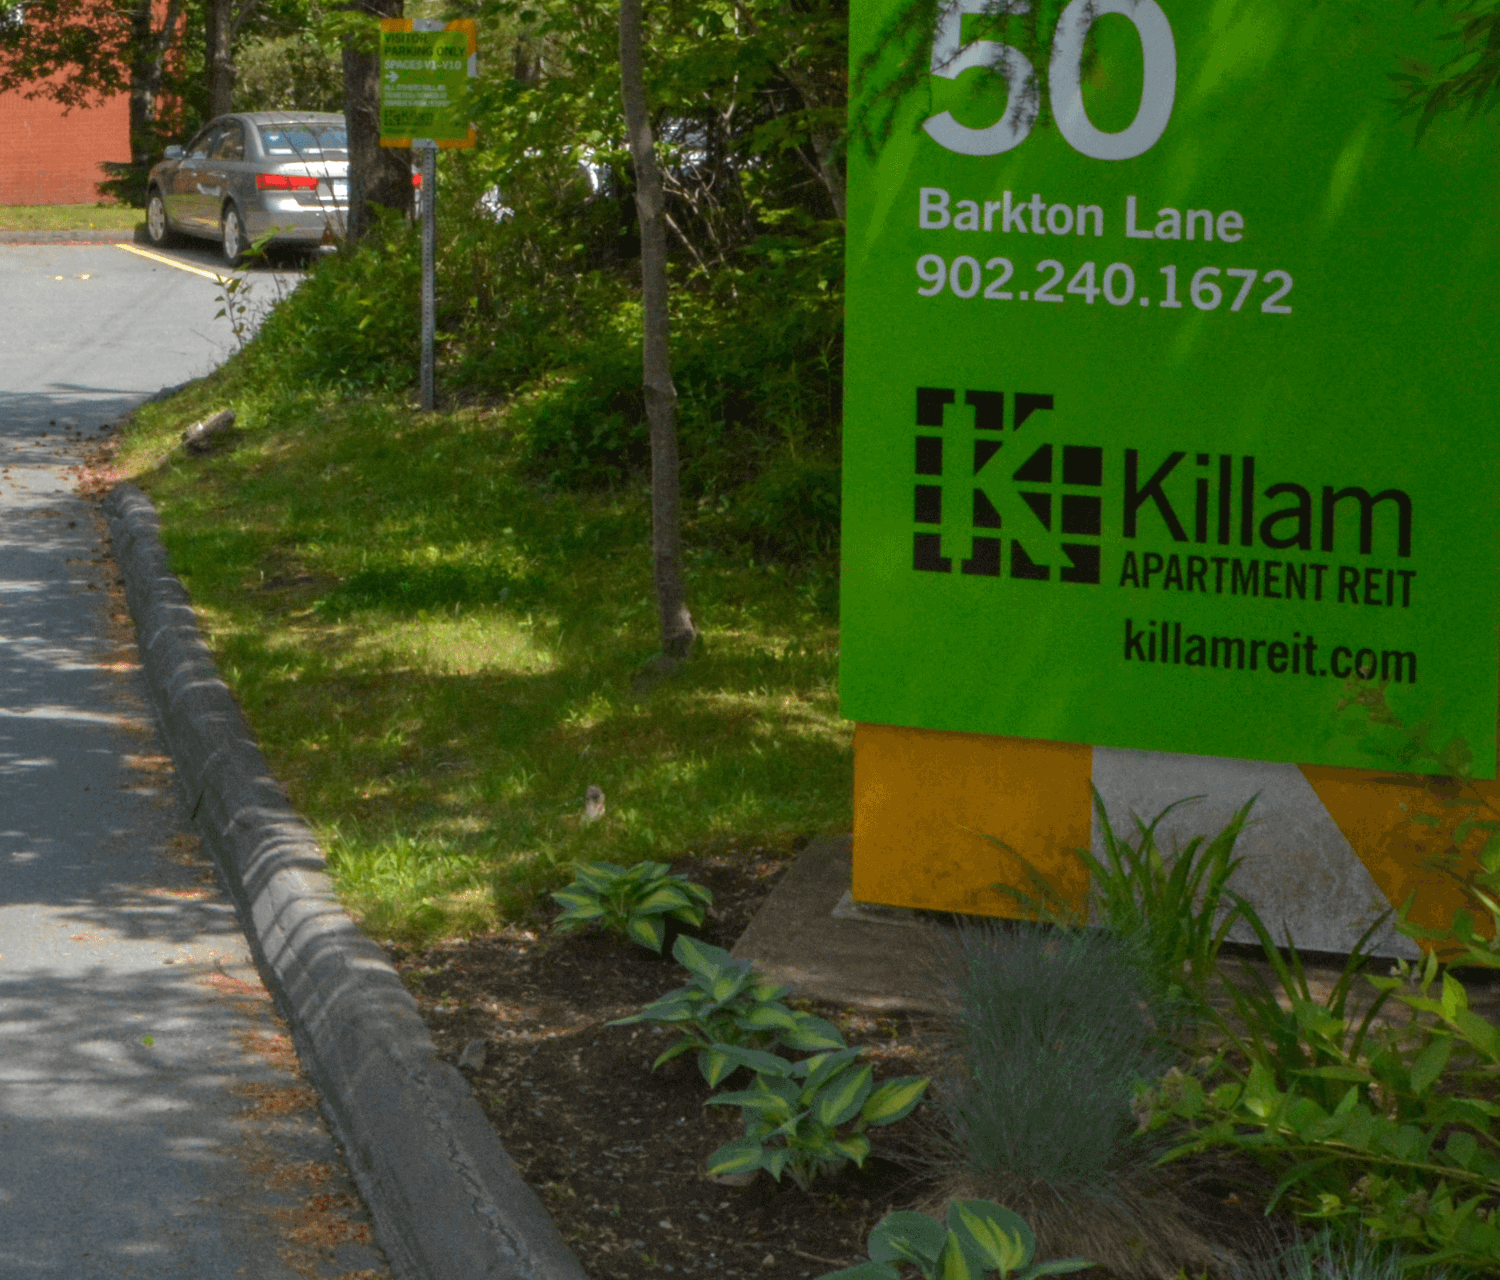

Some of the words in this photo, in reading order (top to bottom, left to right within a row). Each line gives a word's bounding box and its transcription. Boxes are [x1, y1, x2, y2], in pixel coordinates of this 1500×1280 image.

[384, 45, 433, 56] PARKING
[436, 45, 464, 56] ONLY
[918, 187, 1104, 237] Barkton
[1125, 195, 1244, 243] Lane
[916, 253, 1294, 315] 902.240.1672
[1122, 449, 1413, 558] Killam
[1119, 550, 1329, 601] APARTMENT
[1336, 565, 1417, 608] REIT
[1124, 619, 1418, 684] killamreit.com
